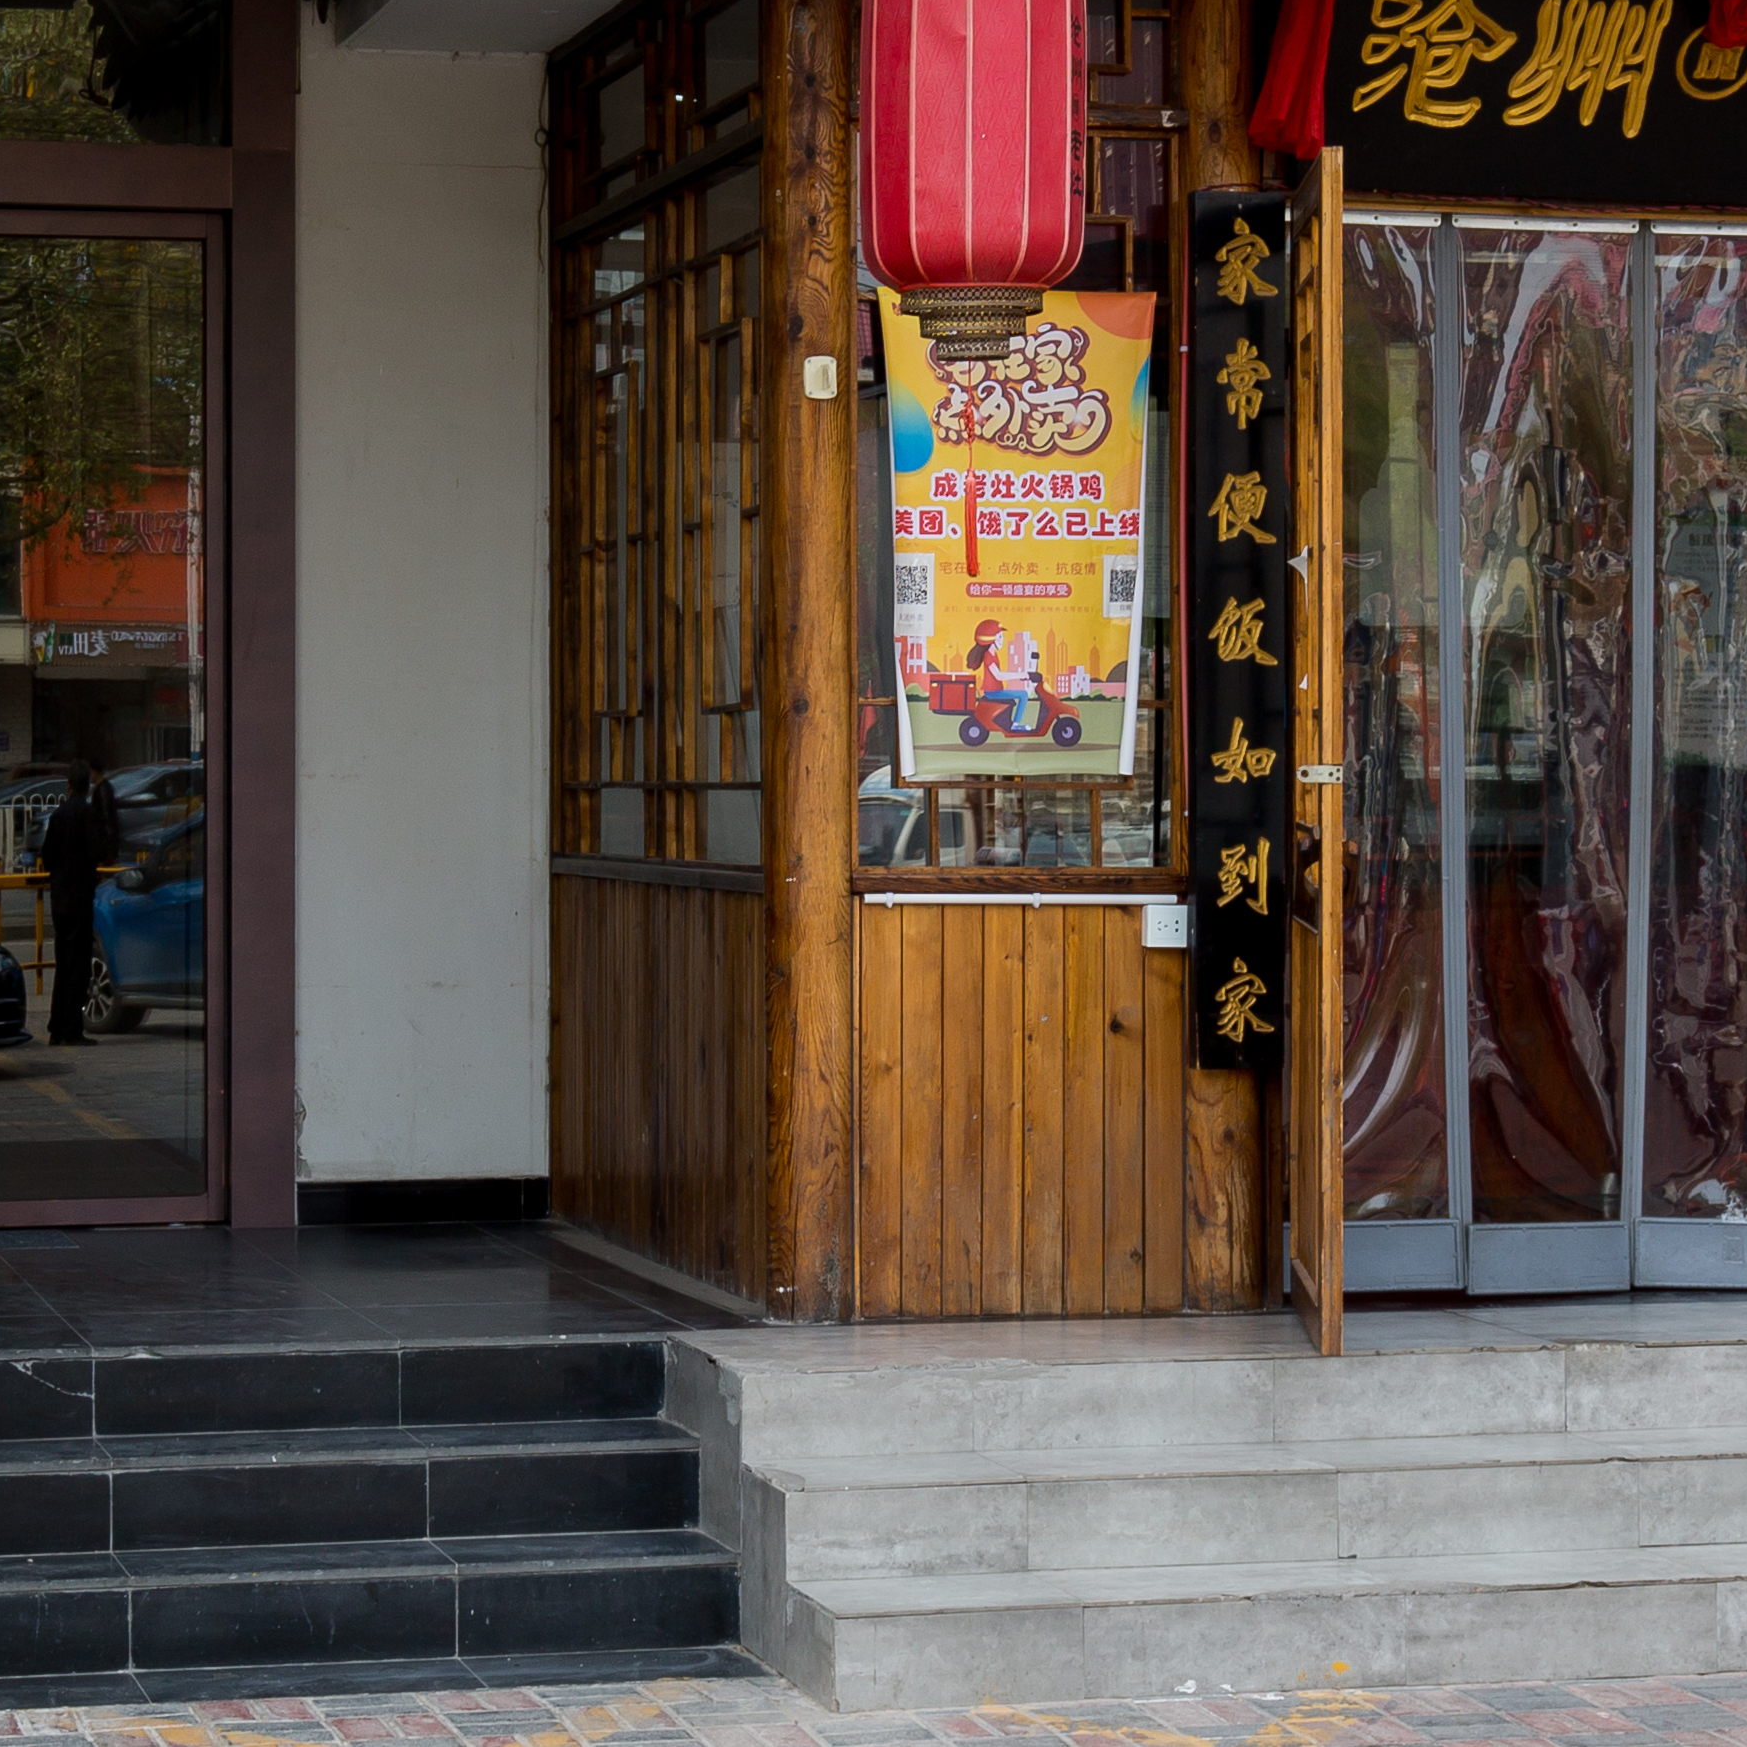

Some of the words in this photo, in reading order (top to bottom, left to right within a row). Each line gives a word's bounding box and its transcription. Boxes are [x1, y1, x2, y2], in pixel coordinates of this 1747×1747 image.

[932, 471, 1103, 501] 成老灶火锅鸡
[997, 561, 1040, 576] 点外卖
[1055, 561, 1097, 576] 抗疫情
[969, 583, 1069, 597] 给你一顿盛宴的享受
[1208, 216, 1278, 1044] 家常便饭如到家
